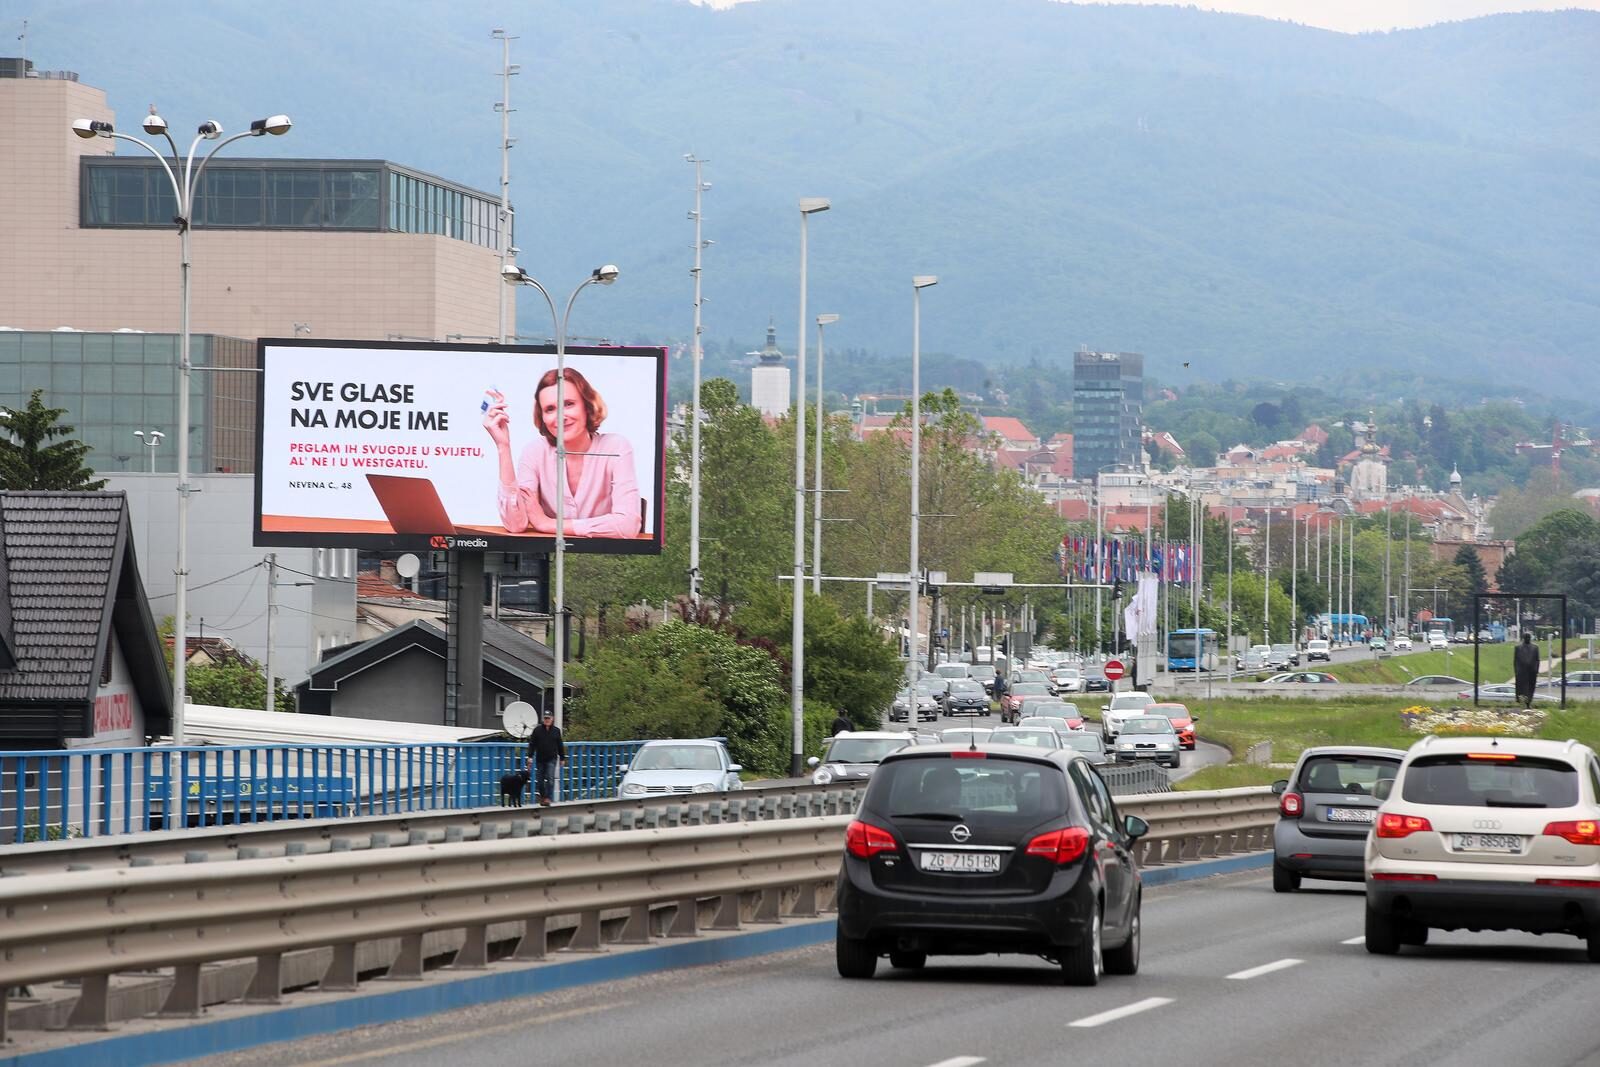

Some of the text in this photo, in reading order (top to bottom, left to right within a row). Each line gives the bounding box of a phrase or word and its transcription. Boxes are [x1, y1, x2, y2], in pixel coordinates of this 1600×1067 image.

[290, 381, 414, 403] SVE GLASE
[290, 408, 449, 431] NA MOJE IME
[290, 443, 485, 458] PEGLAM IH SVUGDJE U SVIJETU,
[311, 457, 328, 466] NE
[340, 457, 348, 467] U
[353, 458, 428, 469] WESTGATEU.
[289, 481, 325, 489] NEVENA
[341, 482, 352, 490] 48
[457, 538, 488, 547] media
[1460, 834, 1473, 847] ZG
[930, 854, 945, 866] ZG
